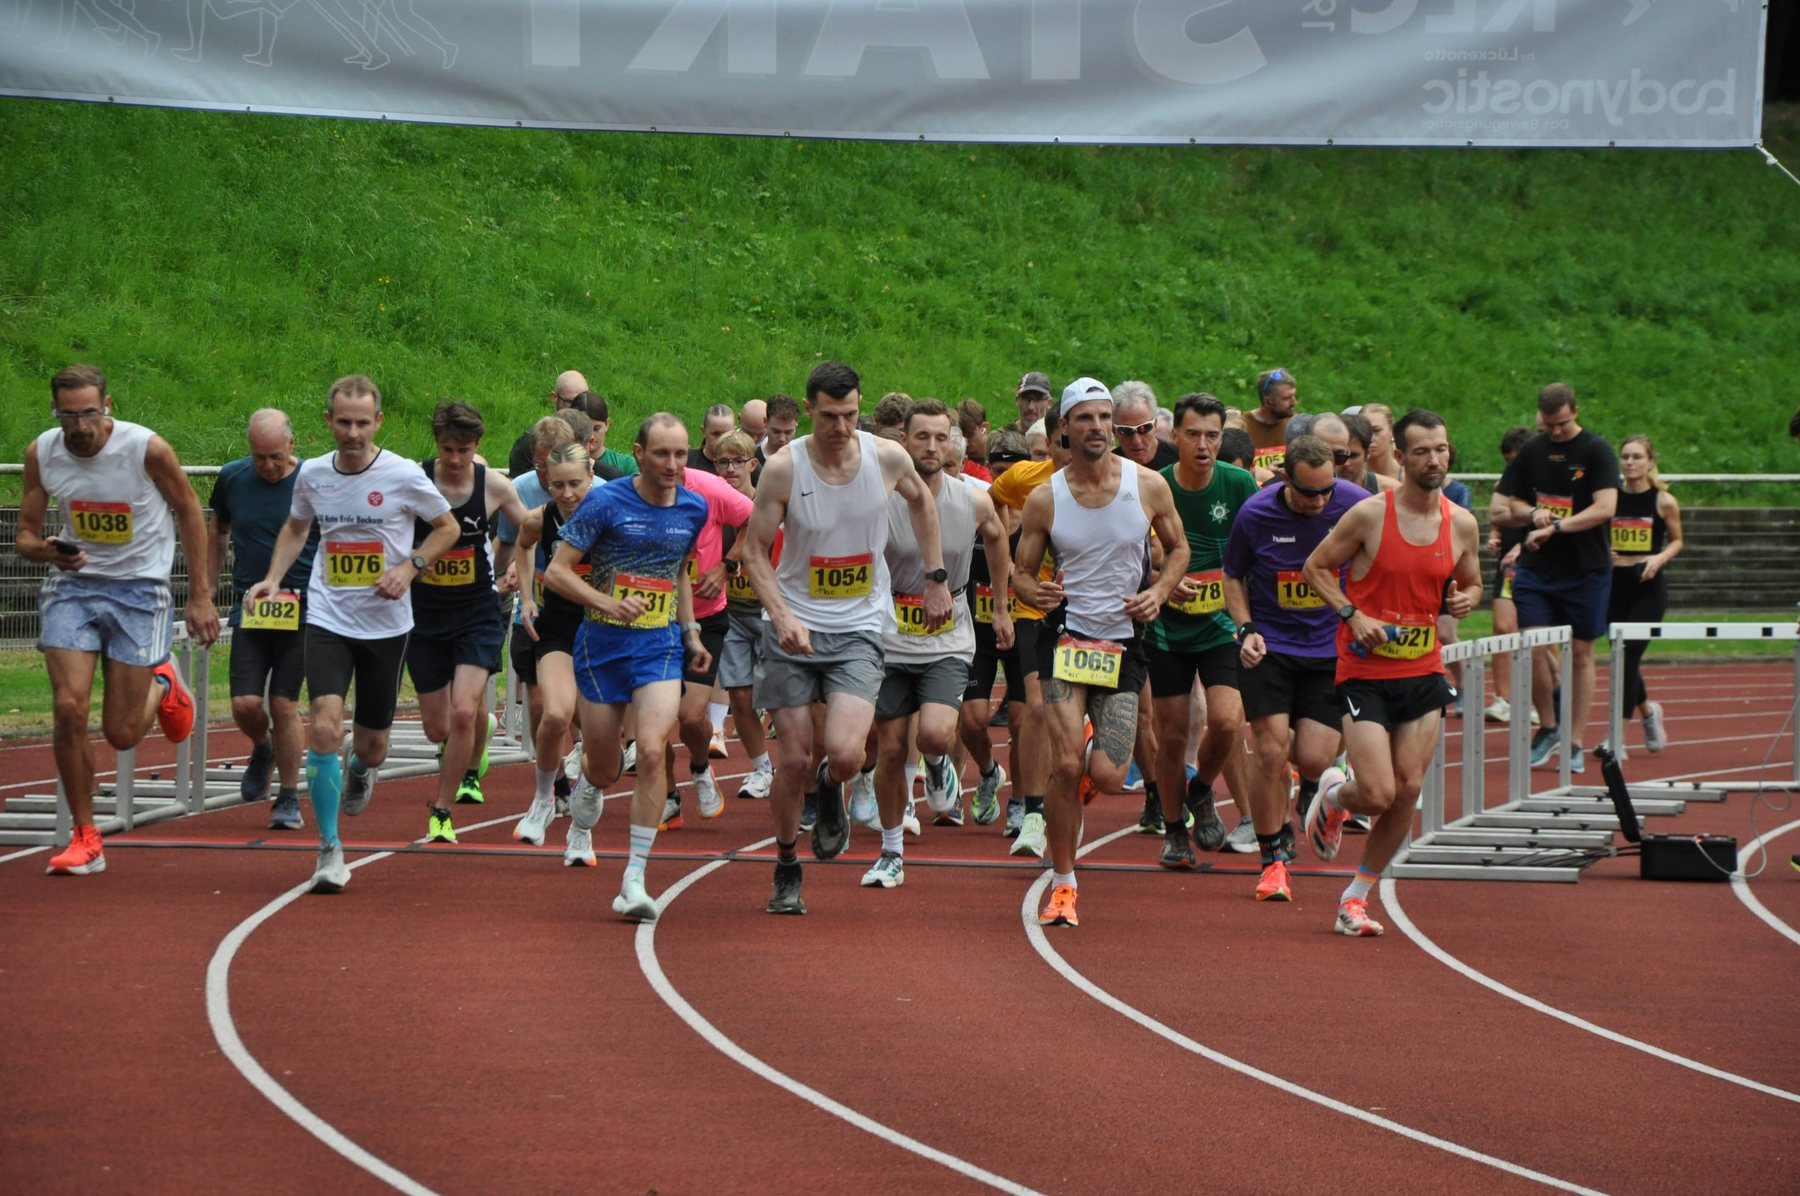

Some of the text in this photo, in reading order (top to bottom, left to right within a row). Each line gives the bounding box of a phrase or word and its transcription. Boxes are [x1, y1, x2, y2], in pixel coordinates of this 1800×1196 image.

[76, 512, 128, 532] 1038
[1272, 535, 1296, 543] hummel
[1613, 529, 1648, 542] 1015
[330, 554, 381, 574] 1076
[434, 559, 471, 576] 063
[815, 566, 868, 588] 1054
[1283, 583, 1318, 598] 10
[258, 600, 295, 618] 082
[900, 606, 924, 625] 10
[1387, 627, 1430, 647] 021
[1062, 648, 1115, 673] 1065
